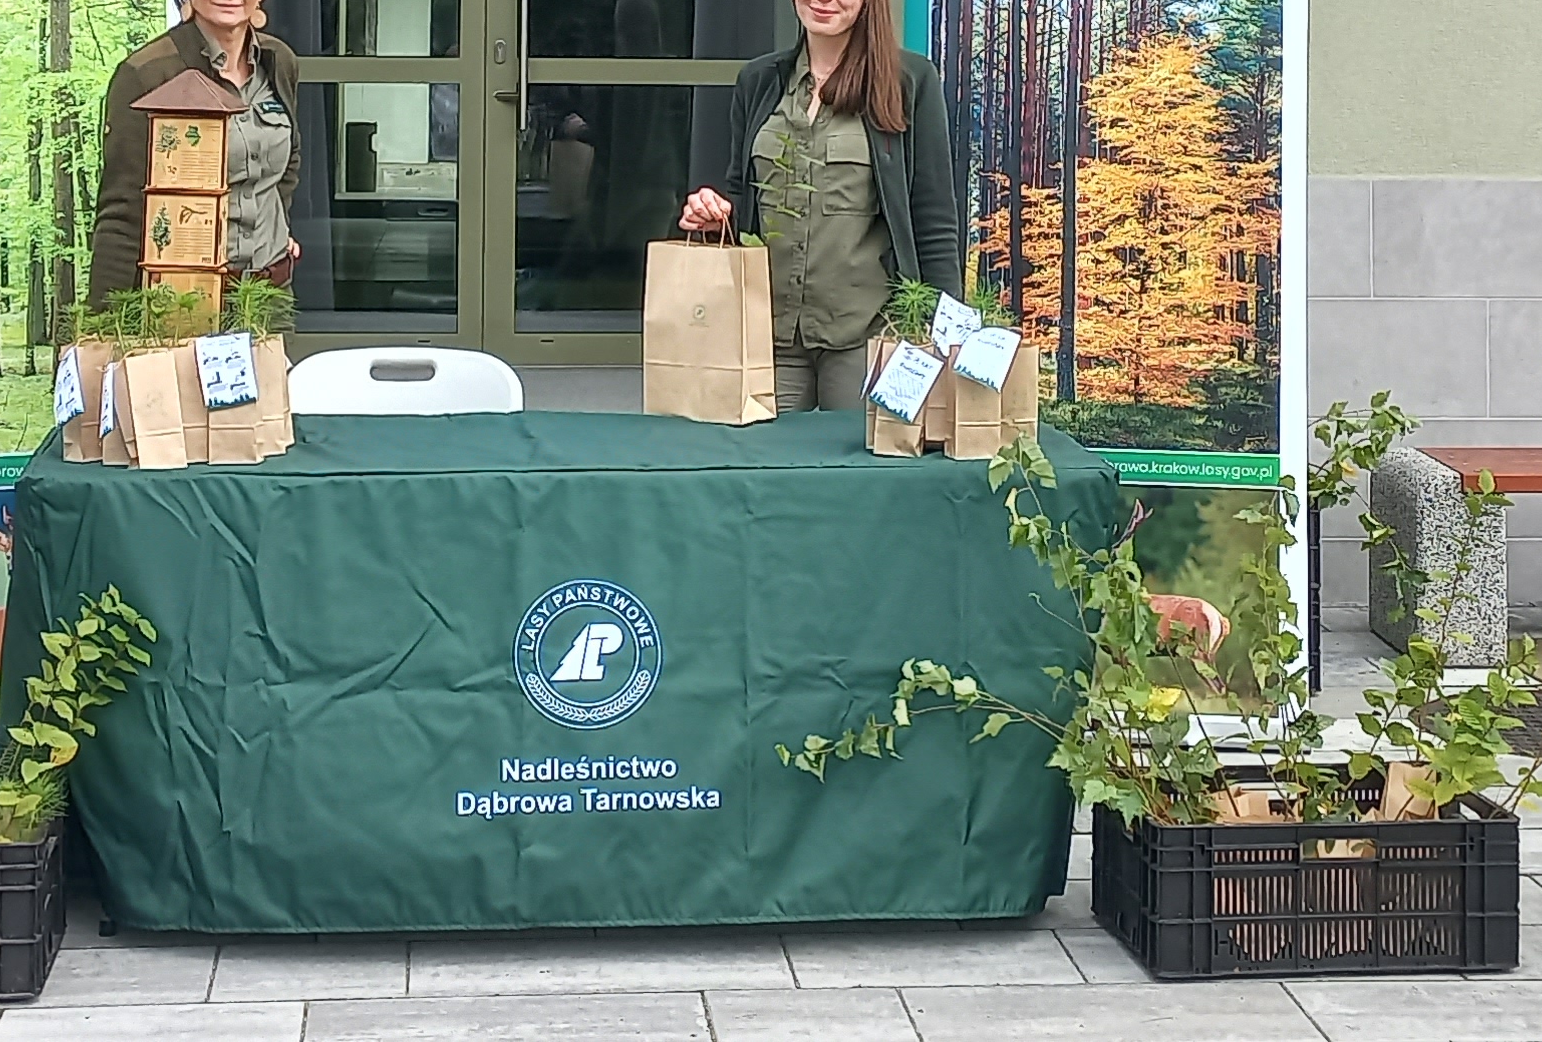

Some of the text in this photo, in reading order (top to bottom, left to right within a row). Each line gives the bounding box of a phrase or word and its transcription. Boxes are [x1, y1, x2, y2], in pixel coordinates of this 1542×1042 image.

[521, 584, 655, 652] LASY PAŃSTWOWE
[501, 755, 677, 782] Nadleśnictwo
[457, 786, 720, 820] Dąbrowa Tarnowska
